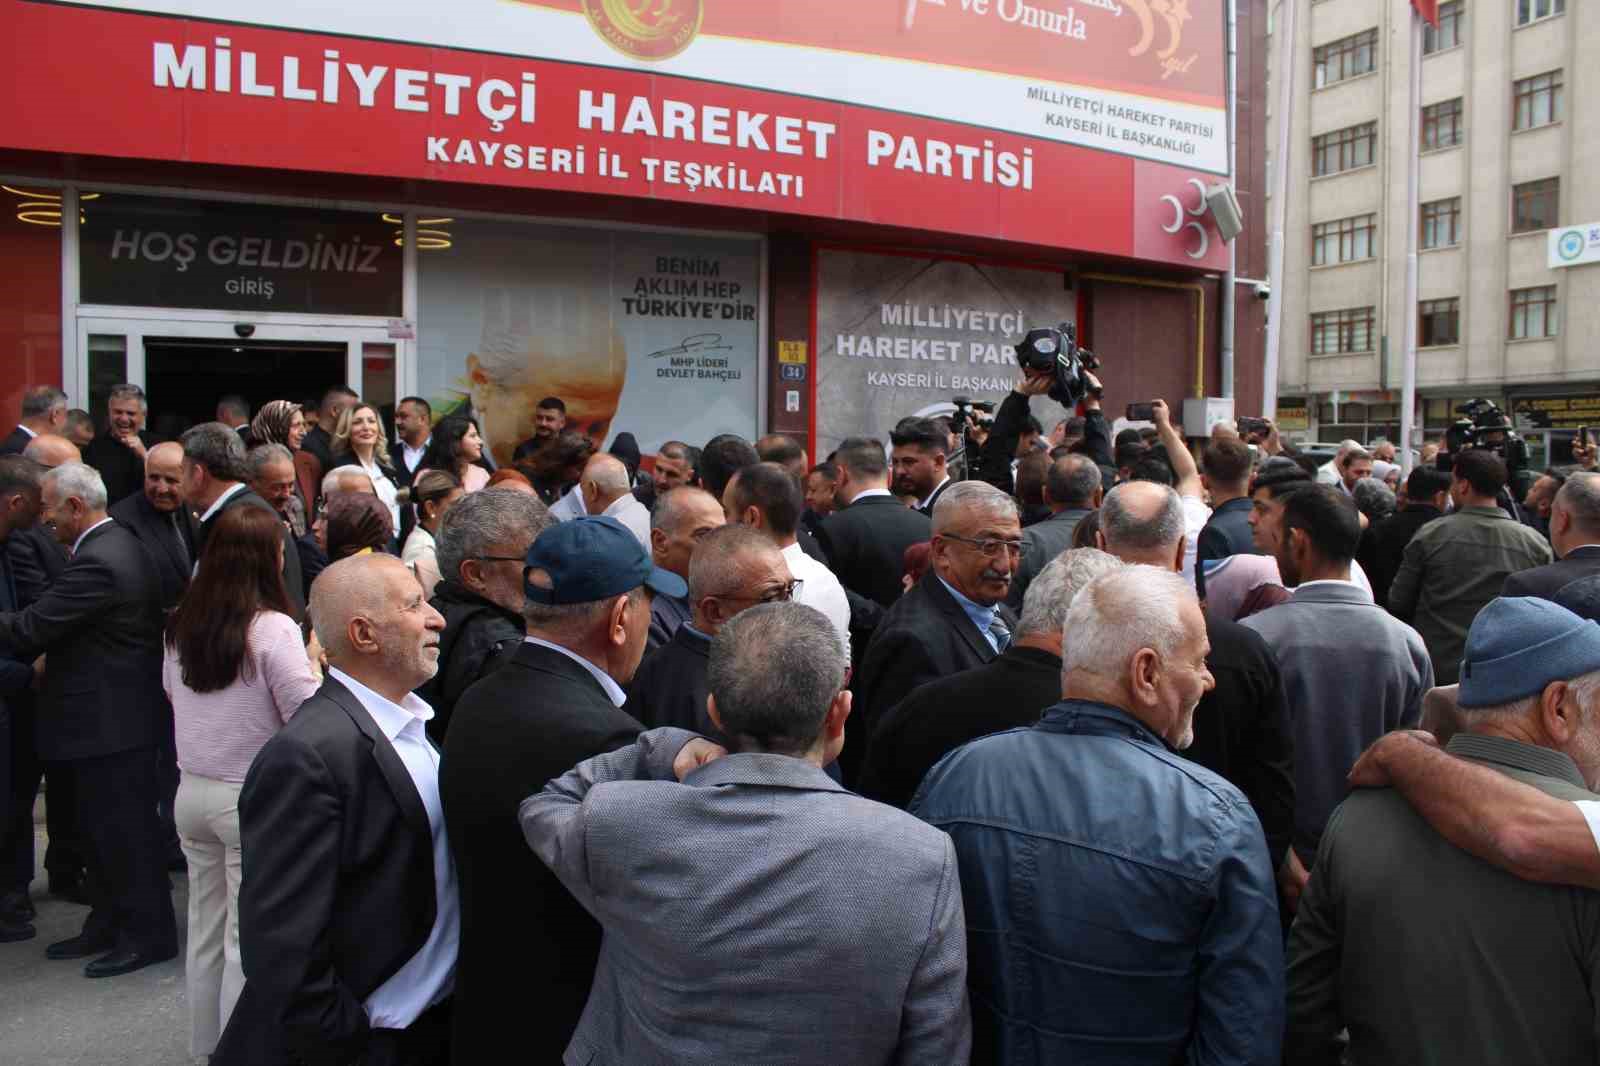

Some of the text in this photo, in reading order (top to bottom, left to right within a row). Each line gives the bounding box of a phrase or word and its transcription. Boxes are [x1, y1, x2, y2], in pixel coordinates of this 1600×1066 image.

[997, 0, 1086, 40] Onurla
[153, 37, 1034, 190] MİLLİYETÇİ HAREKET PARTİSİ
[1026, 86, 1213, 140] MİLLİYETÇİ HAREKET PARTİSİ
[1045, 113, 1196, 155] KAYSERİ İL BAŞKANLIĞI
[426, 136, 804, 198] KAYSERİ İL TEŞKİLATI
[111, 229, 384, 273] HOŞ GELDİNİZ
[656, 256, 720, 277] BENİM
[225, 276, 274, 300] GİRİŞ
[634, 277, 742, 299] AKLIM HEP
[622, 294, 756, 321] TÜRKİYE'DİR
[881, 300, 1024, 338] MİLLİYETÇİ
[670, 356, 728, 369] MHP LİDERİ
[836, 334, 1017, 365] HAREKET PAR
[656, 368, 741, 382] DEVLET BAHÇELİ
[867, 370, 930, 388] KAYSERİ
[935, 371, 947, 389] İL
